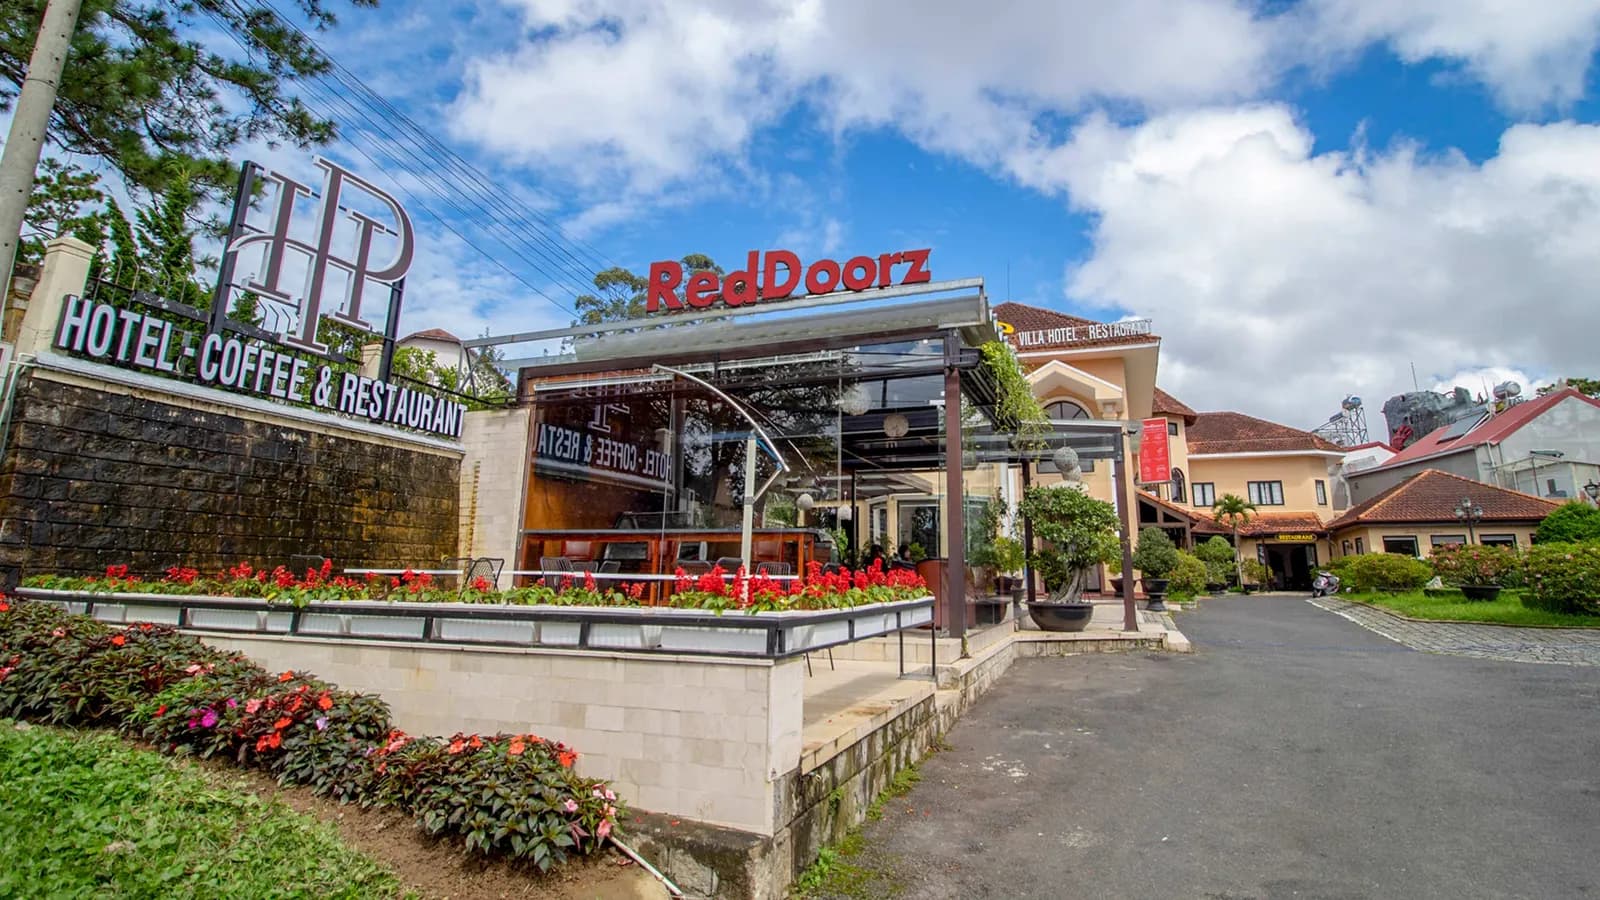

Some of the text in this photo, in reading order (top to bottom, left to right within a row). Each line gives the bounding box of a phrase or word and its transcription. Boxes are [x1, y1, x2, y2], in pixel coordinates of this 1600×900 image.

[646, 248, 932, 312] RedDoorz
[57, 295, 176, 372] HOTEL
[199, 333, 309, 402] COFFEE
[313, 365, 334, 407] &
[339, 373, 468, 438] RESTAURANT
[1018, 330, 1045, 345] VILLA
[1047, 327, 1078, 344] HOTEL
